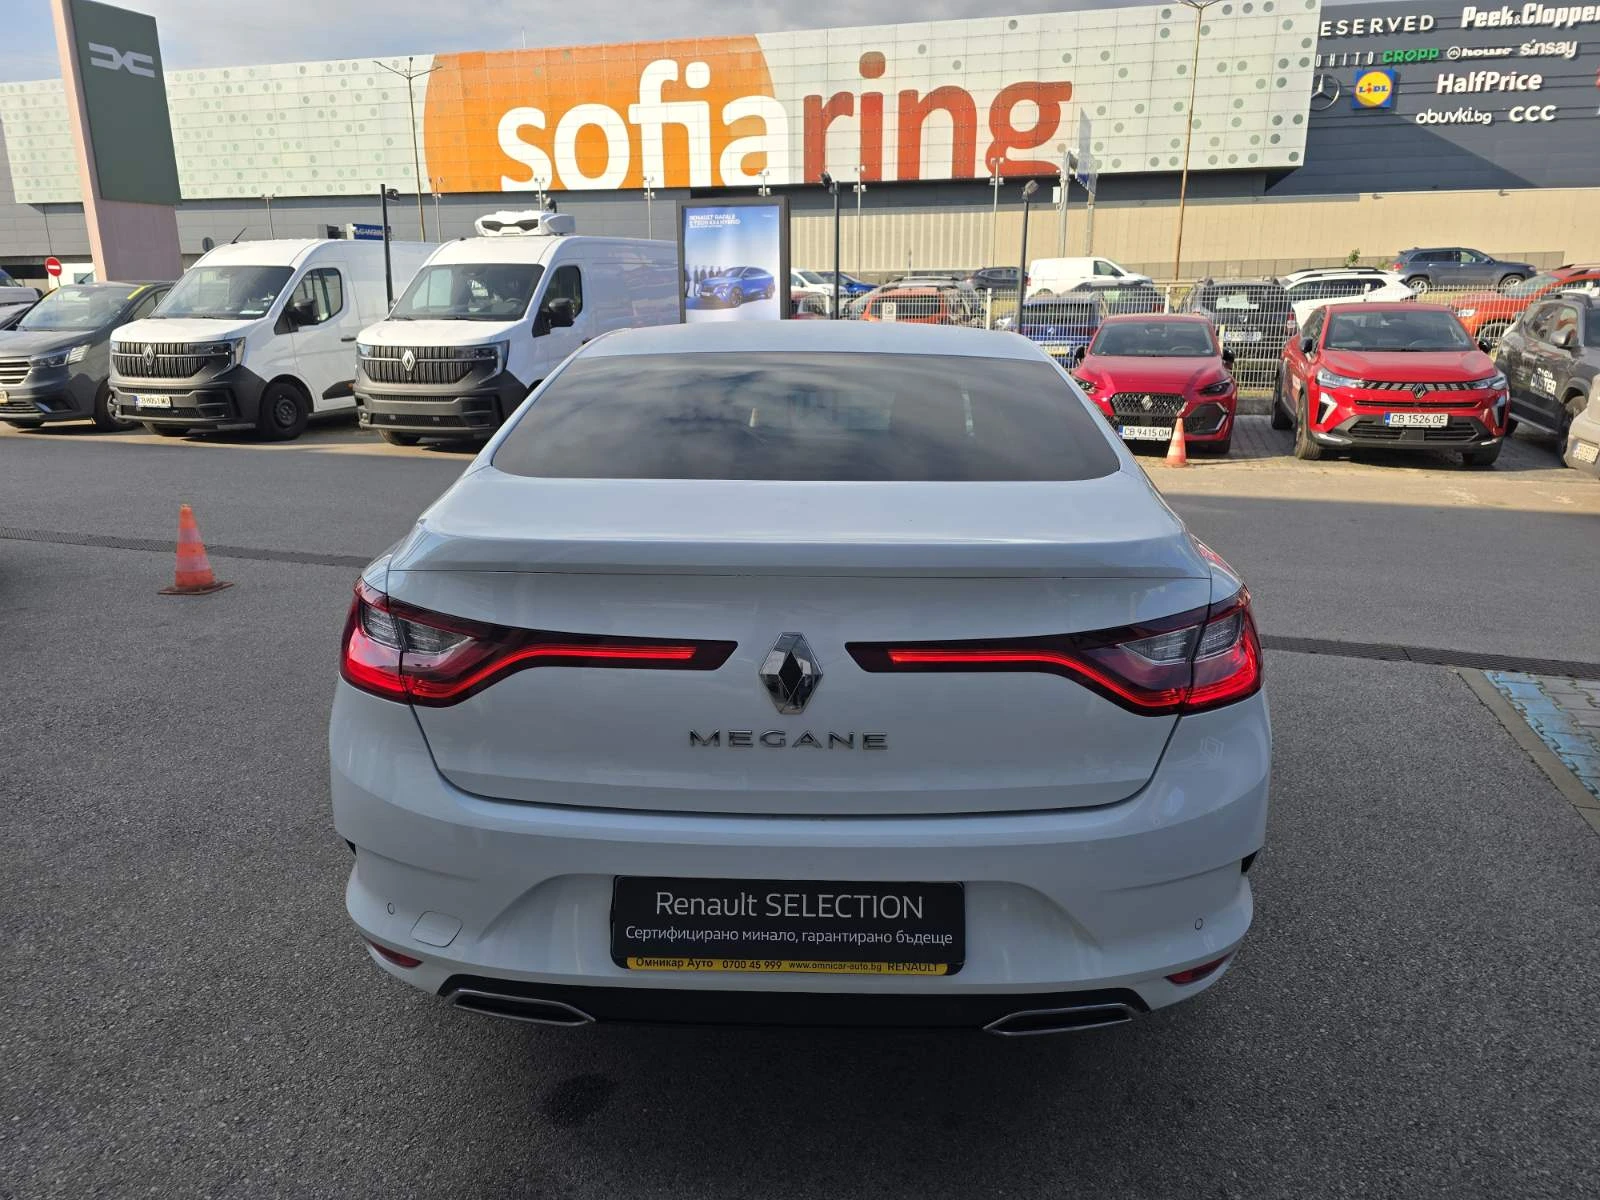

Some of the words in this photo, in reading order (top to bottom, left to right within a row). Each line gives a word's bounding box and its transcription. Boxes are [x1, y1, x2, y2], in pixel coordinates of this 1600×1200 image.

[1320, 15, 1434, 36] ESERVED
[1519, 39, 1577, 59] sinsay
[1315, 51, 1374, 67] OHITO
[1437, 71, 1543, 94] HalfPrice
[1416, 107, 1492, 125] obuvki.bg
[1509, 105, 1557, 122] CCC
[1391, 414, 1405, 424] CB
[1409, 414, 1431, 424] 1526
[1433, 415, 1446, 424] OE
[1137, 428, 1157, 437] 9415
[1159, 429, 1170, 437] OM
[690, 728, 888, 750] MEGANE
[656, 892, 757, 916] Renault
[765, 893, 923, 919] SELECTION
[626, 926, 738, 943] Сертифицирано
[743, 931, 799, 943] минало,
[802, 931, 893, 946] гарантирано
[896, 930, 953, 946] бъдеще
[636, 957, 684, 969] Омникар
[687, 957, 714, 969] Ауто
[722, 960, 746, 969] 0700
[748, 961, 761, 969] 45
[764, 961, 782, 969] 999
[788, 961, 882, 972] www.omnicar-auto.bg
[887, 962, 937, 972] RENAULT
